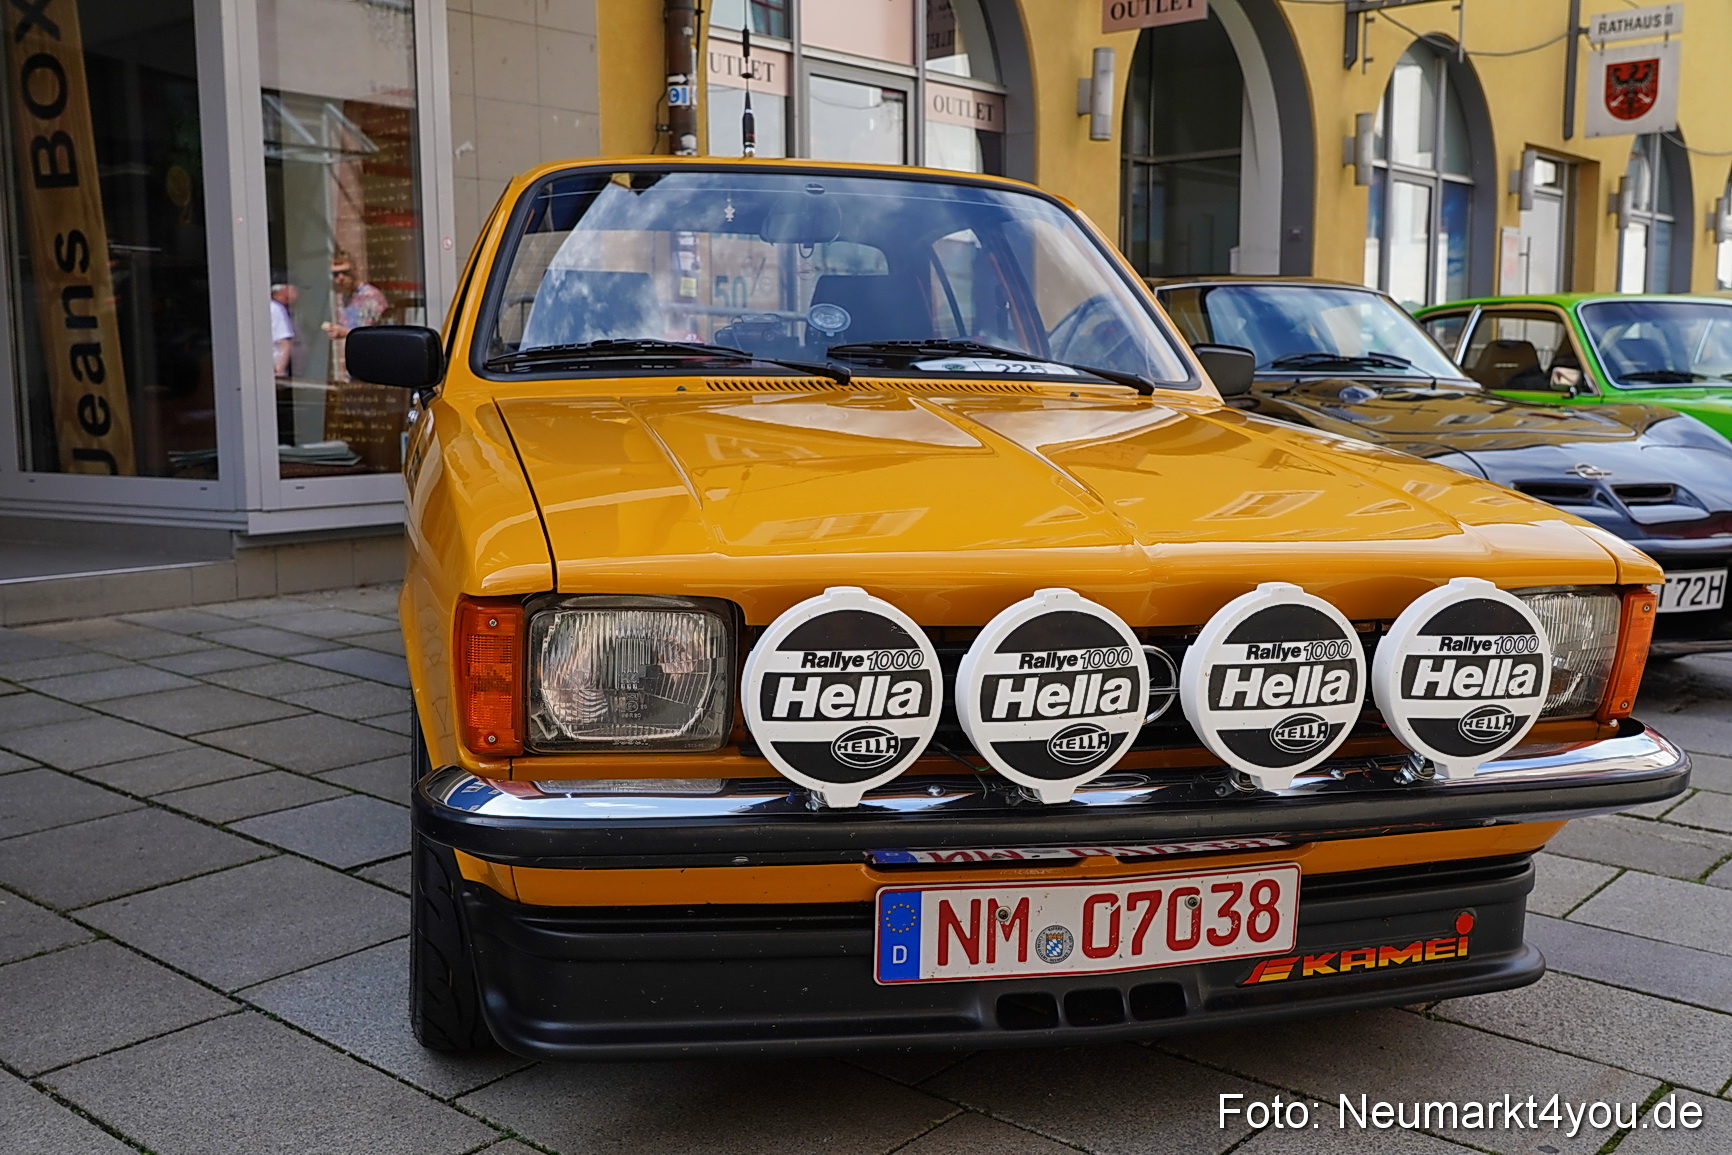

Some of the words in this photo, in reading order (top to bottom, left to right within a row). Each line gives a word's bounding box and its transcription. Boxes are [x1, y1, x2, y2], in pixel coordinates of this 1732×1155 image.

[1598, 13, 1662, 34] RATHAUS
[933, 94, 994, 121] OUTLET
[55, 228, 118, 475] Jeans
[1246, 643, 1302, 661] Rallye
[1303, 640, 1352, 660] 1000
[1438, 636, 1493, 654] Rallye
[1494, 636, 1539, 654] 1000
[801, 652, 864, 671] Rallye
[867, 650, 924, 670] 1000
[1018, 652, 1078, 671] Rallye
[1080, 647, 1132, 669] 1000
[1218, 664, 1350, 708] Hella
[1410, 658, 1537, 698] Hella
[772, 675, 923, 719] Hella
[992, 673, 1132, 719] Hella
[1275, 722, 1328, 739] HELLA
[1463, 714, 1515, 731] HELLA
[837, 735, 899, 754] HELLA
[1053, 732, 1109, 750] HELLA
[937, 896, 1030, 967] NM
[1081, 879, 1281, 960] 07038
[892, 945, 908, 964] D
